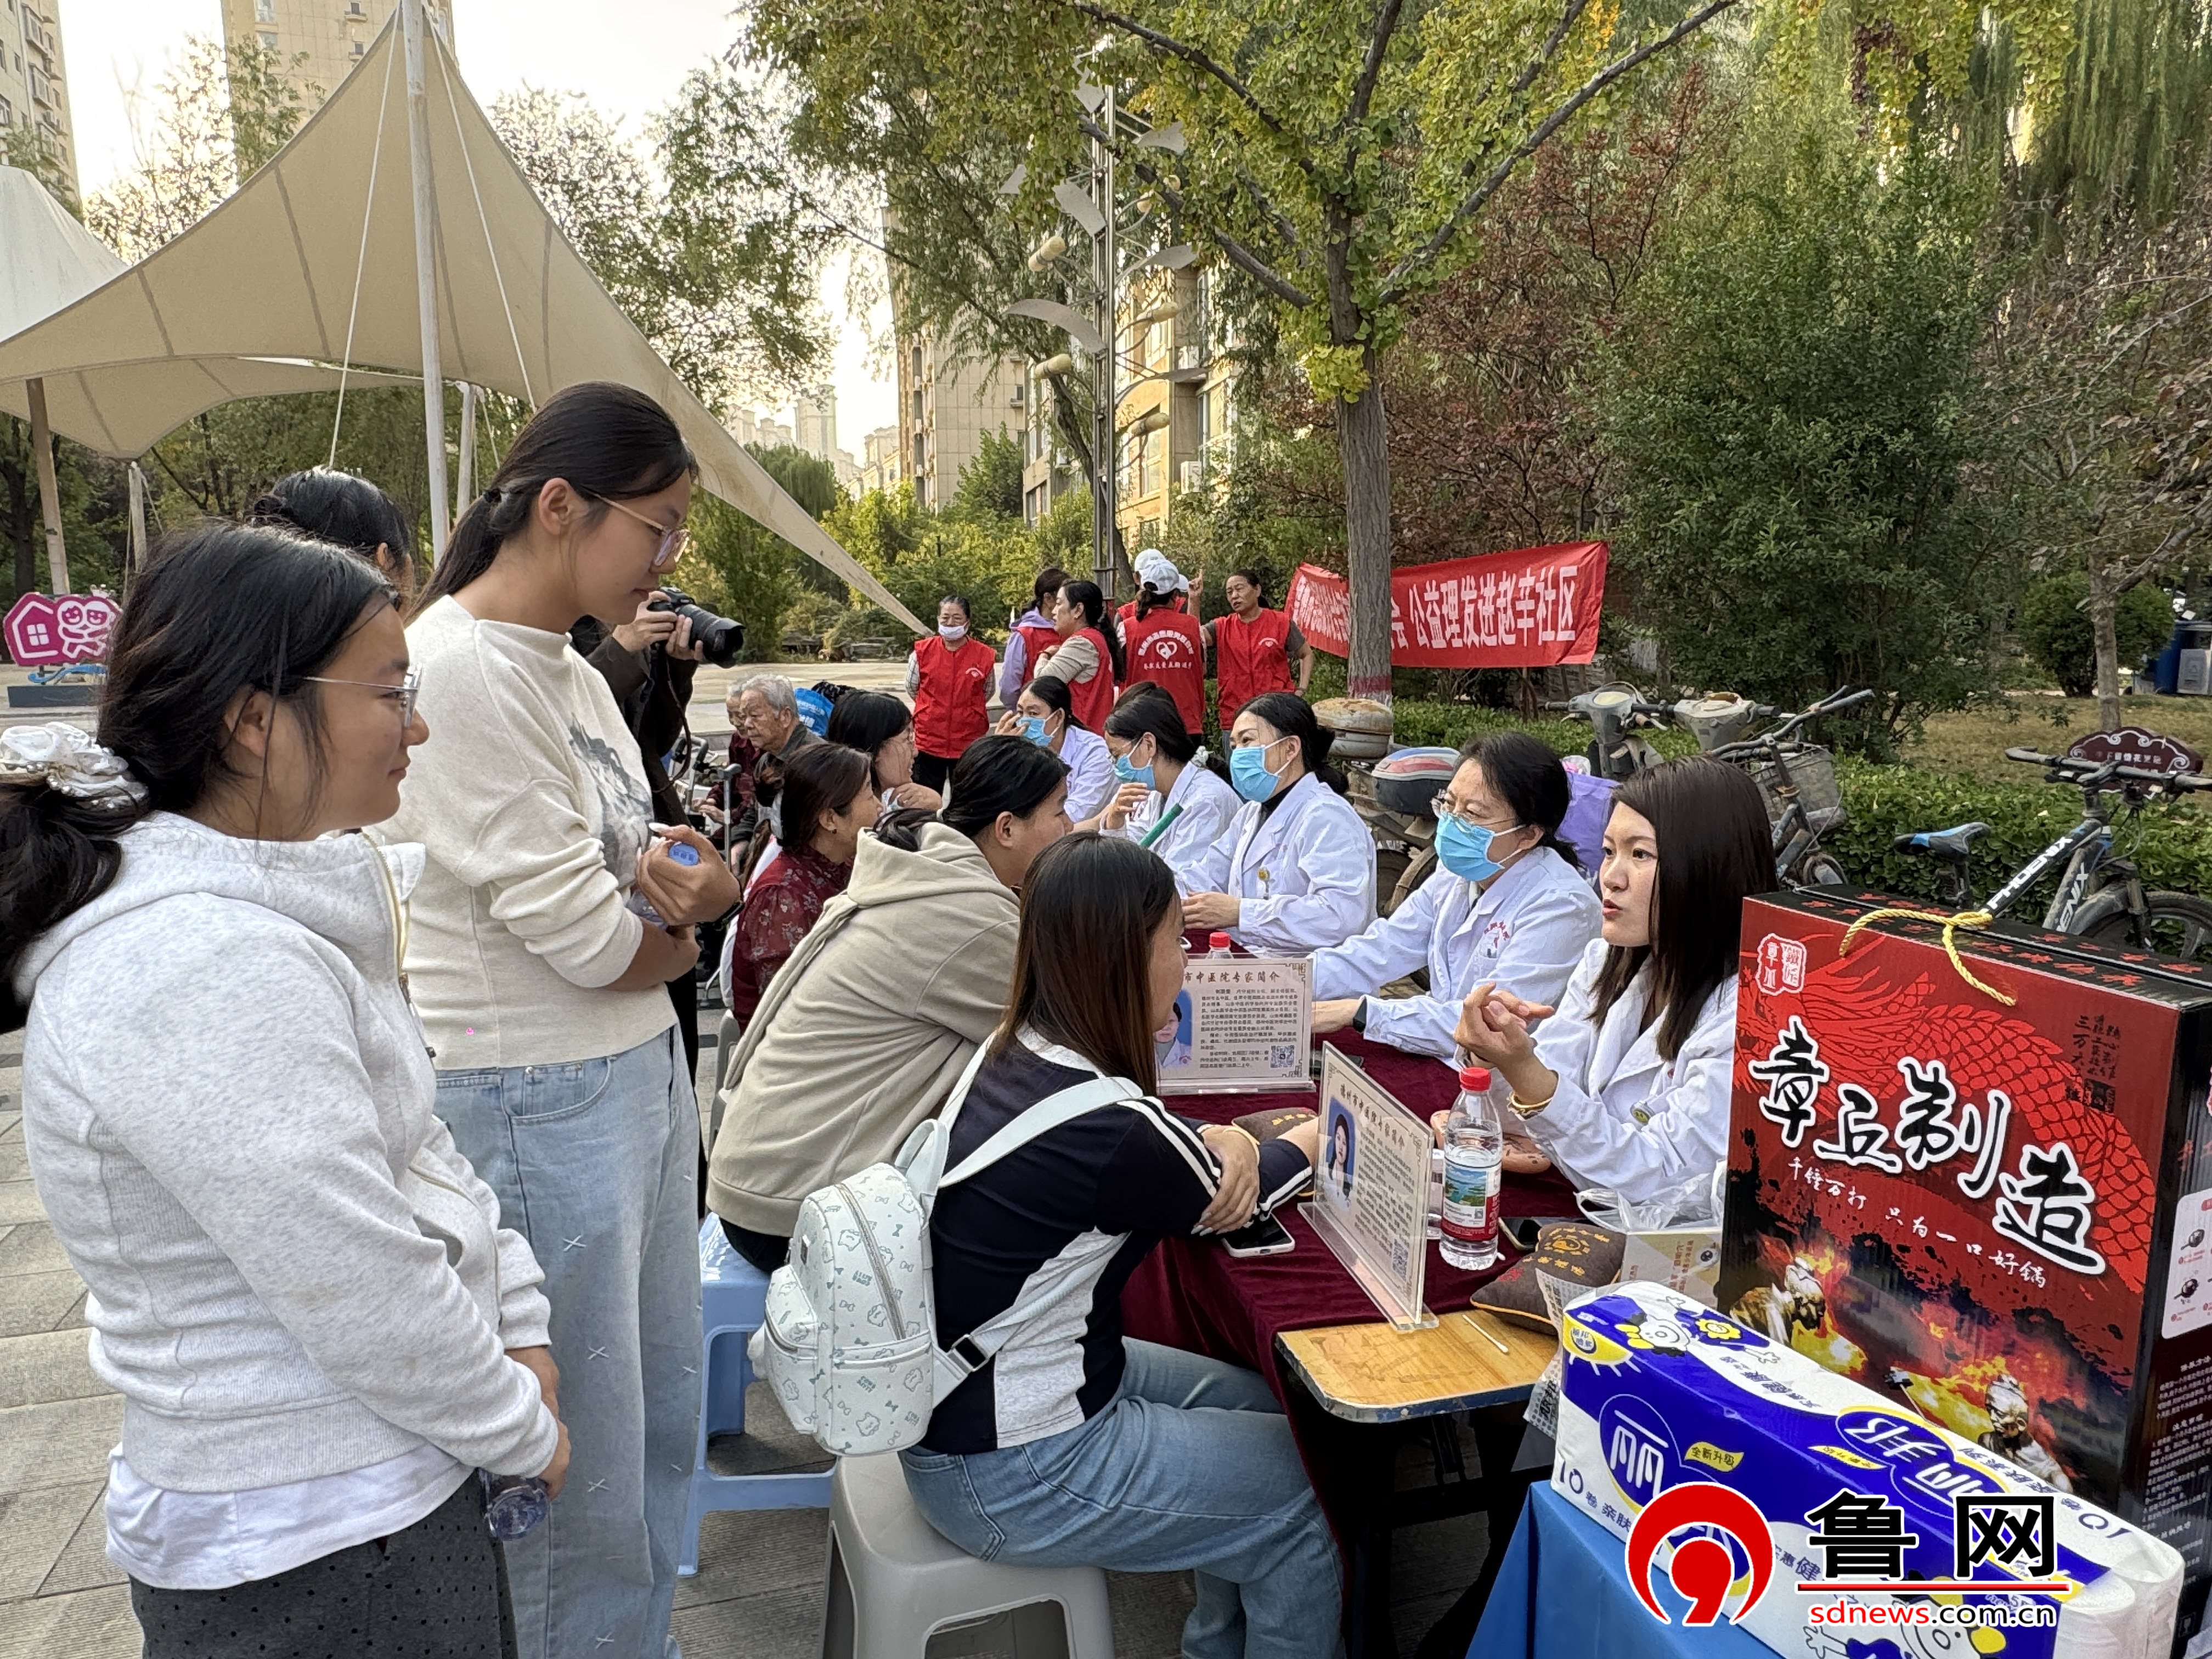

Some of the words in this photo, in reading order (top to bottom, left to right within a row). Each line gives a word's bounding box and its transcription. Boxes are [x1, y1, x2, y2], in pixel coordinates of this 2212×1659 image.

[1987, 836, 2073, 910] PHOENIX
[1748, 1015, 2107, 1274] 章丘制造
[1885, 1206, 2046, 1288] 只为一口好锅
[1691, 1447, 1735, 1467] 全新升级
